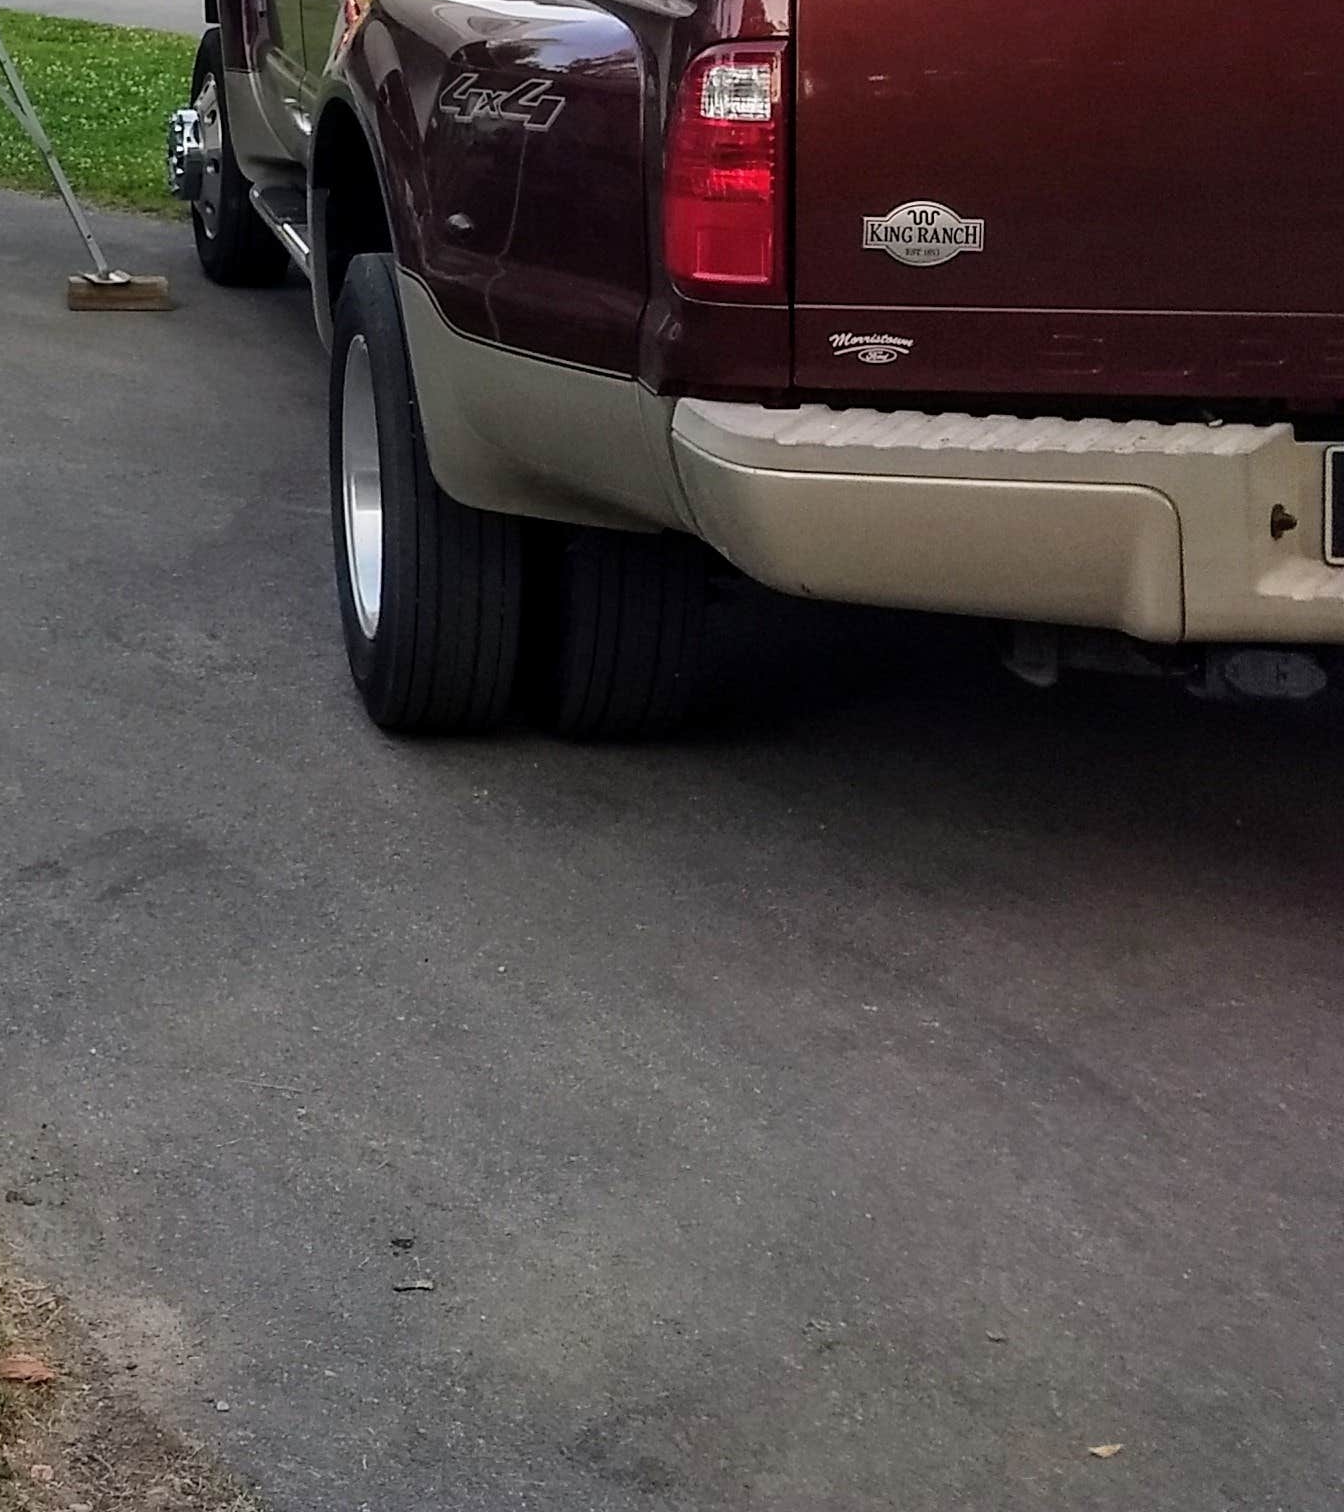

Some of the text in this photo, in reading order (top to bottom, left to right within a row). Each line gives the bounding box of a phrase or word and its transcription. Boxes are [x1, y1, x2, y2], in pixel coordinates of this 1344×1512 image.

[439, 73, 566, 131] 4x4
[869, 223, 977, 245] KING RANCH
[829, 332, 914, 347] Morristown
